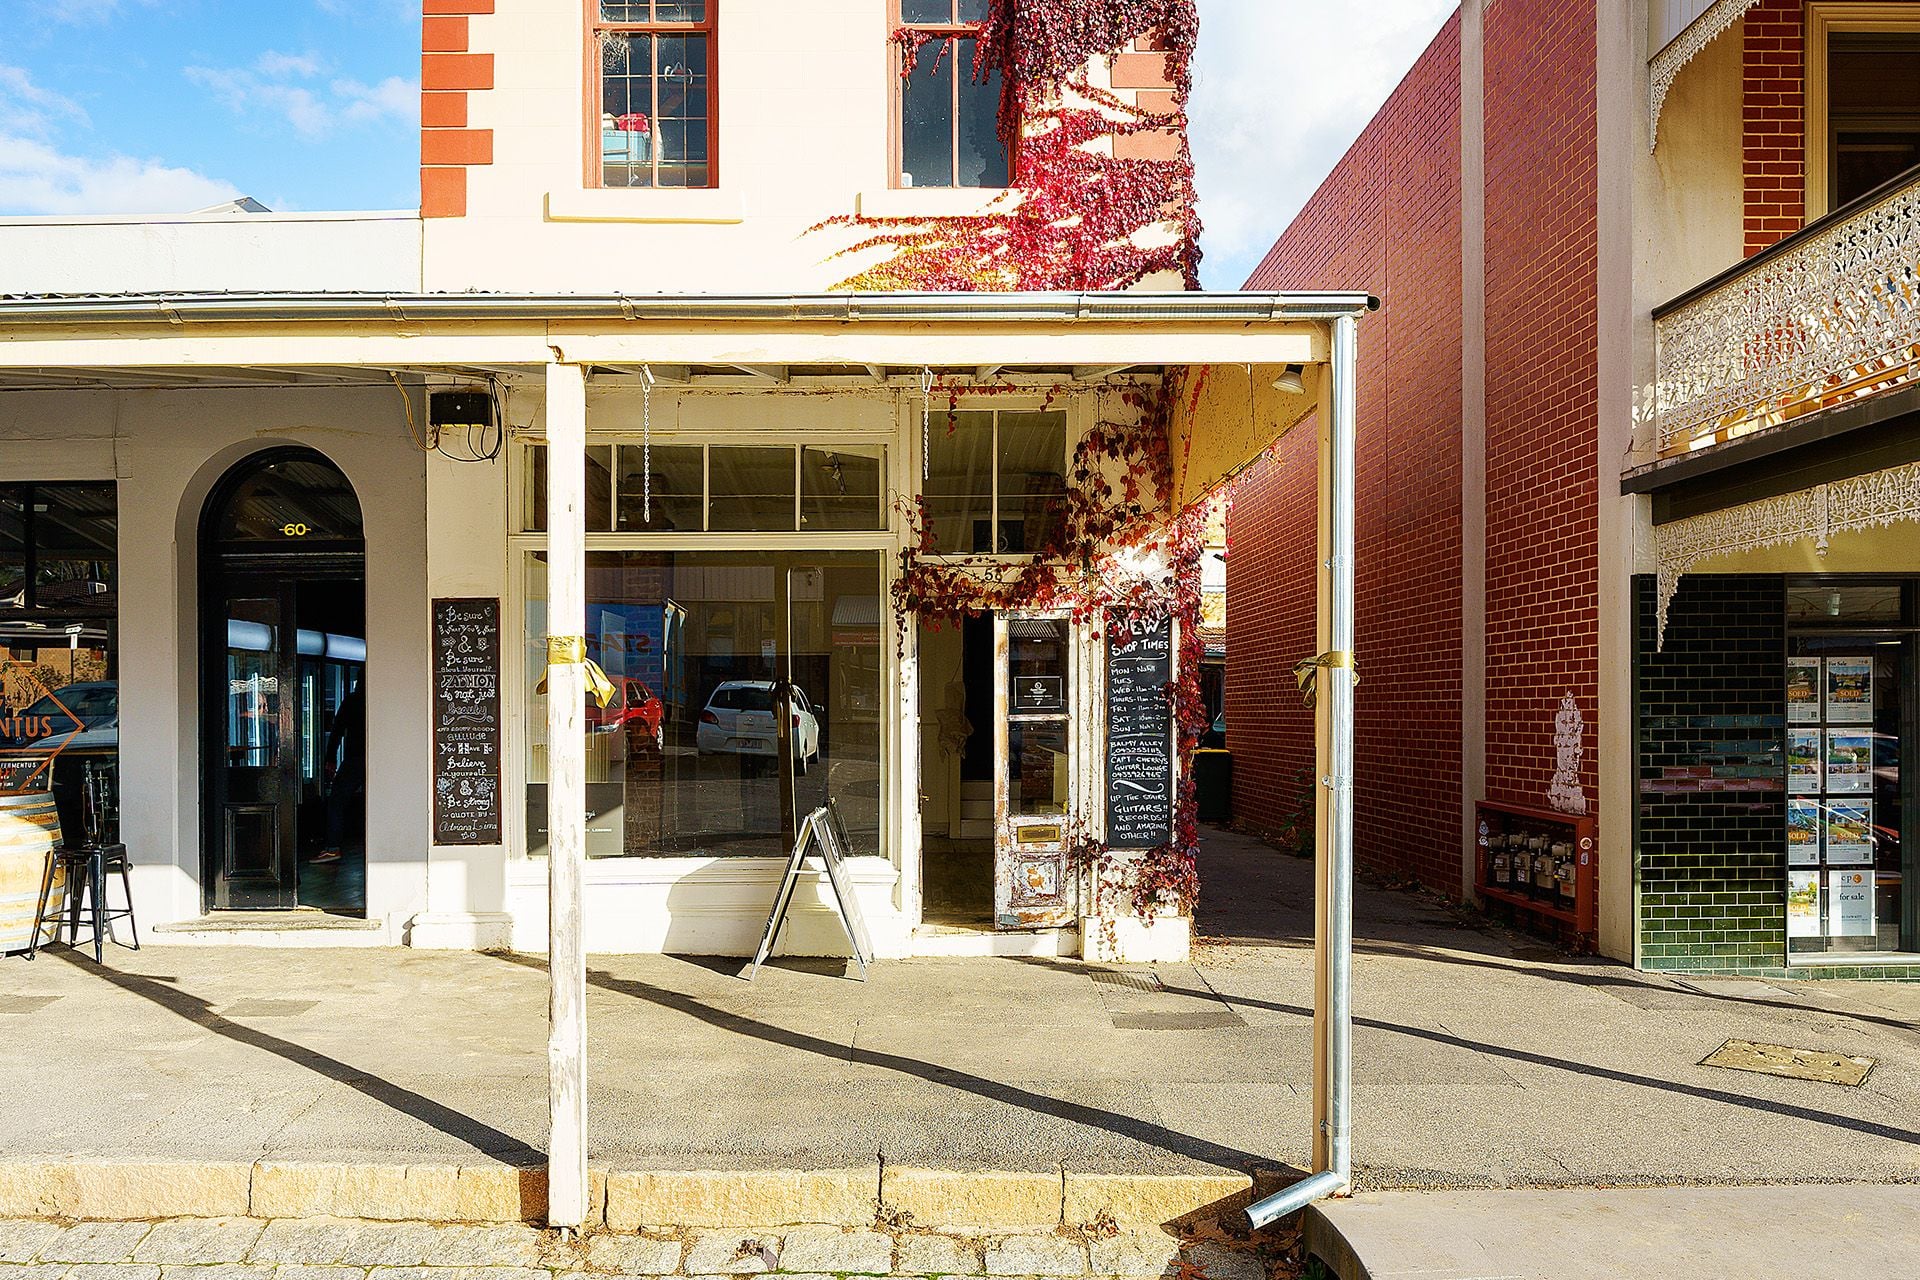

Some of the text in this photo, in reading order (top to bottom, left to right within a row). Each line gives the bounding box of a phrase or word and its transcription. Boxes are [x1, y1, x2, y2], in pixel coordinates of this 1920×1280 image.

[284, 523, 306, 536] 60
[446, 606, 483, 624] Be sure
[1116, 618, 1160, 637] NEW
[458, 635, 472, 653] &
[1111, 638, 1168, 656] SHOP TIMES
[446, 649, 461, 666] Be
[441, 675, 496, 688] FASHION
[447, 756, 486, 770] Believe
[1142, 763, 1168, 772] LOUNGE
[447, 794, 461, 808] Be
[1110, 794, 1121, 802] UP
[1136, 822, 1168, 831] AMAZING
[1840, 892, 1865, 900] for sale
